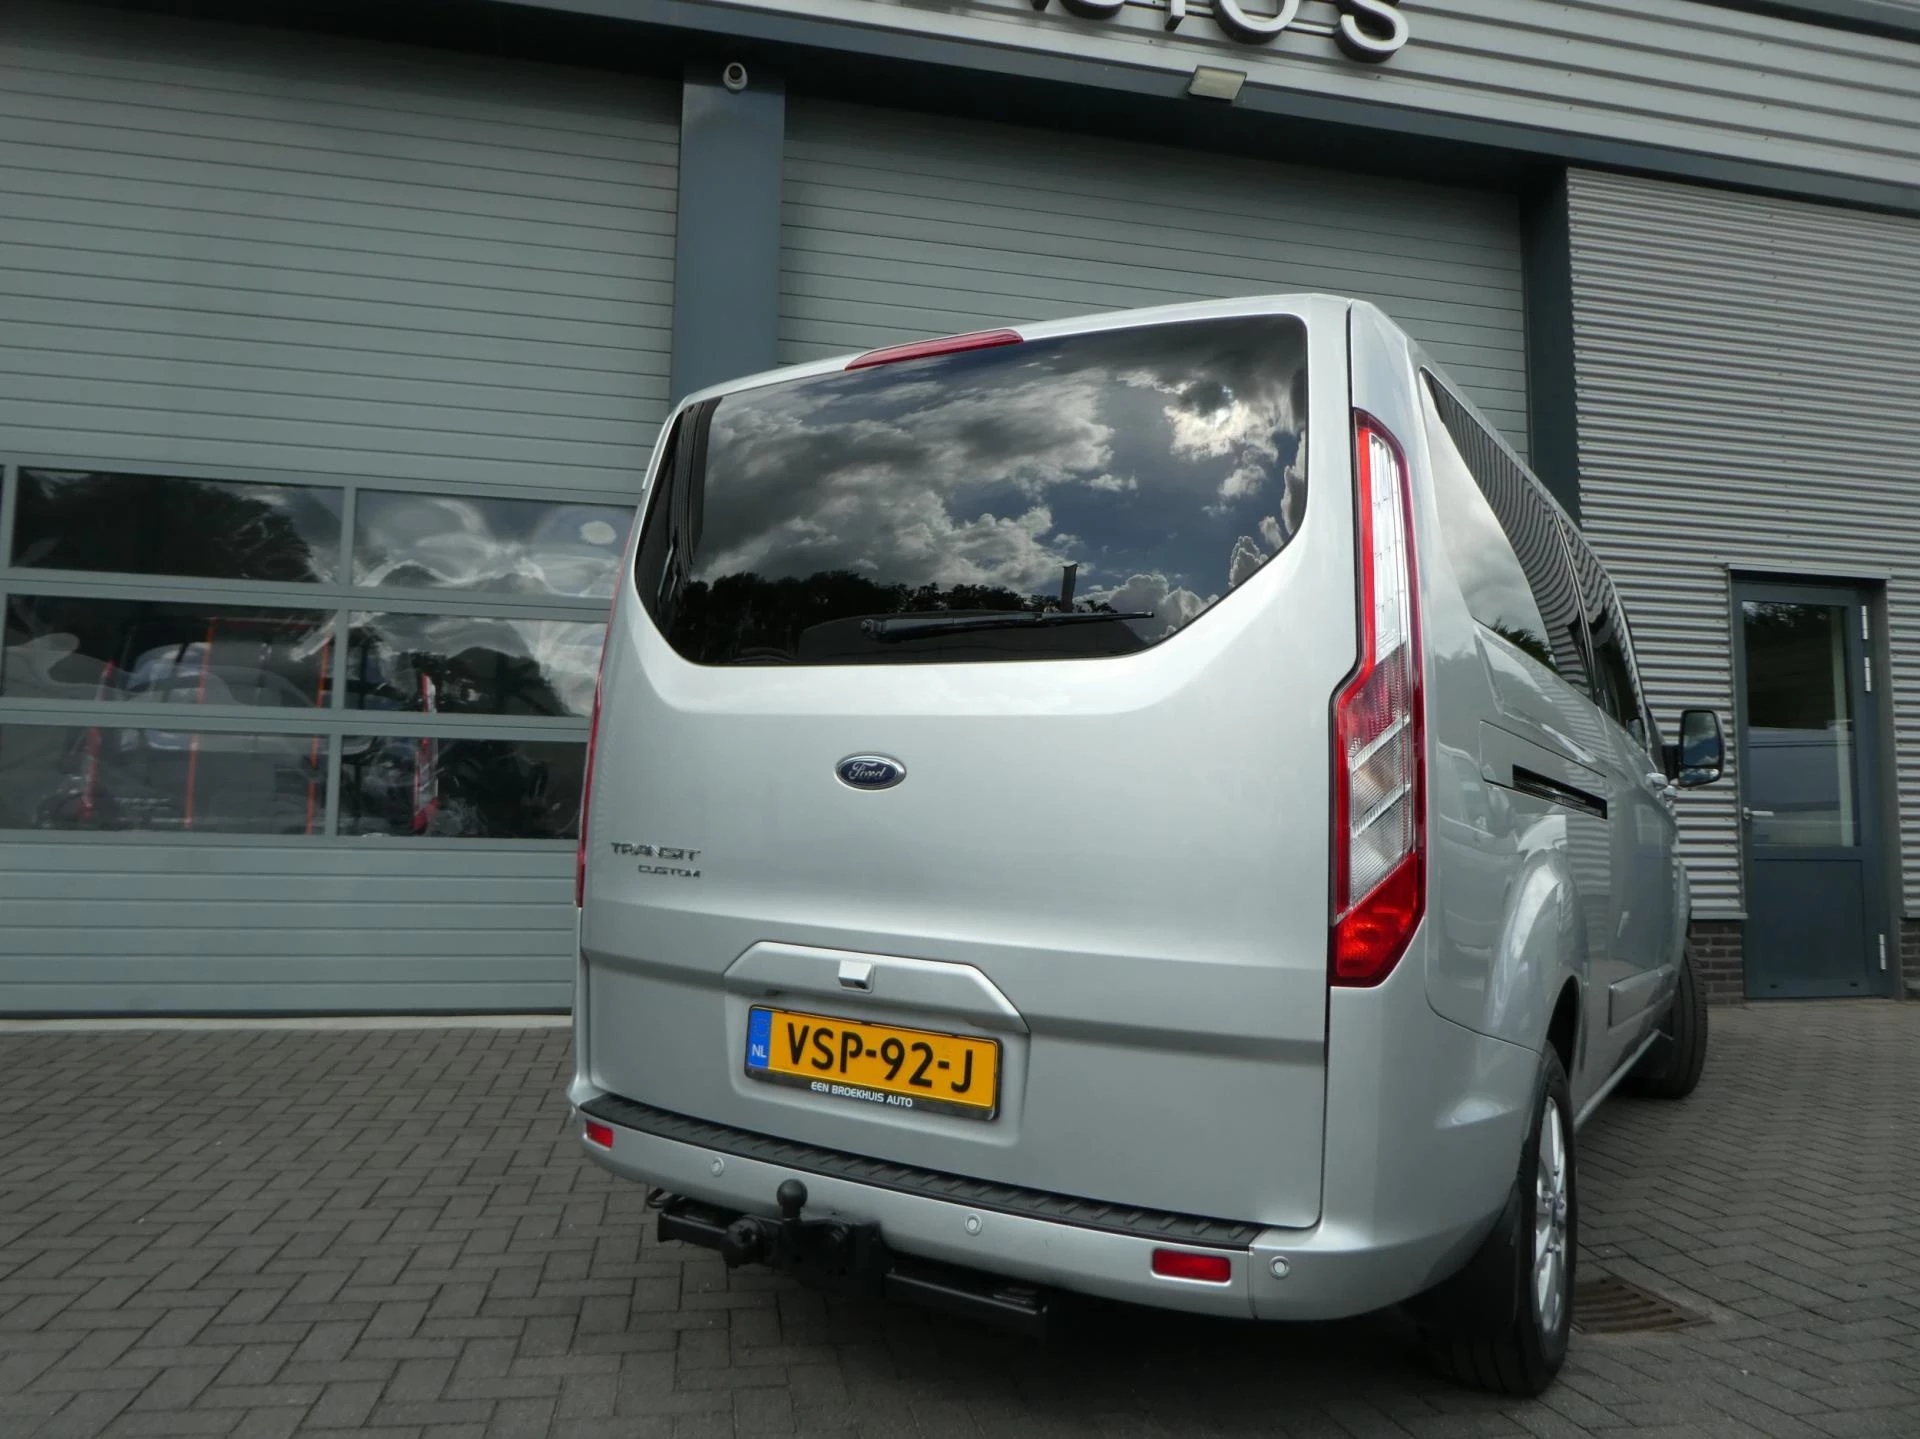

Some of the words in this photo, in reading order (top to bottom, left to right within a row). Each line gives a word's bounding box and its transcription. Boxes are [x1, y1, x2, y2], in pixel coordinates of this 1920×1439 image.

[848, 761, 886, 779] Ford
[610, 842, 701, 861] TRANSIT
[638, 864, 701, 878] CUSTOM
[751, 1043, 767, 1059] NL
[787, 1022, 974, 1094] VSP-92-J
[811, 1081, 829, 1093] EEN
[831, 1084, 884, 1102] BROEKHUIS
[886, 1094, 913, 1107] AUTO
